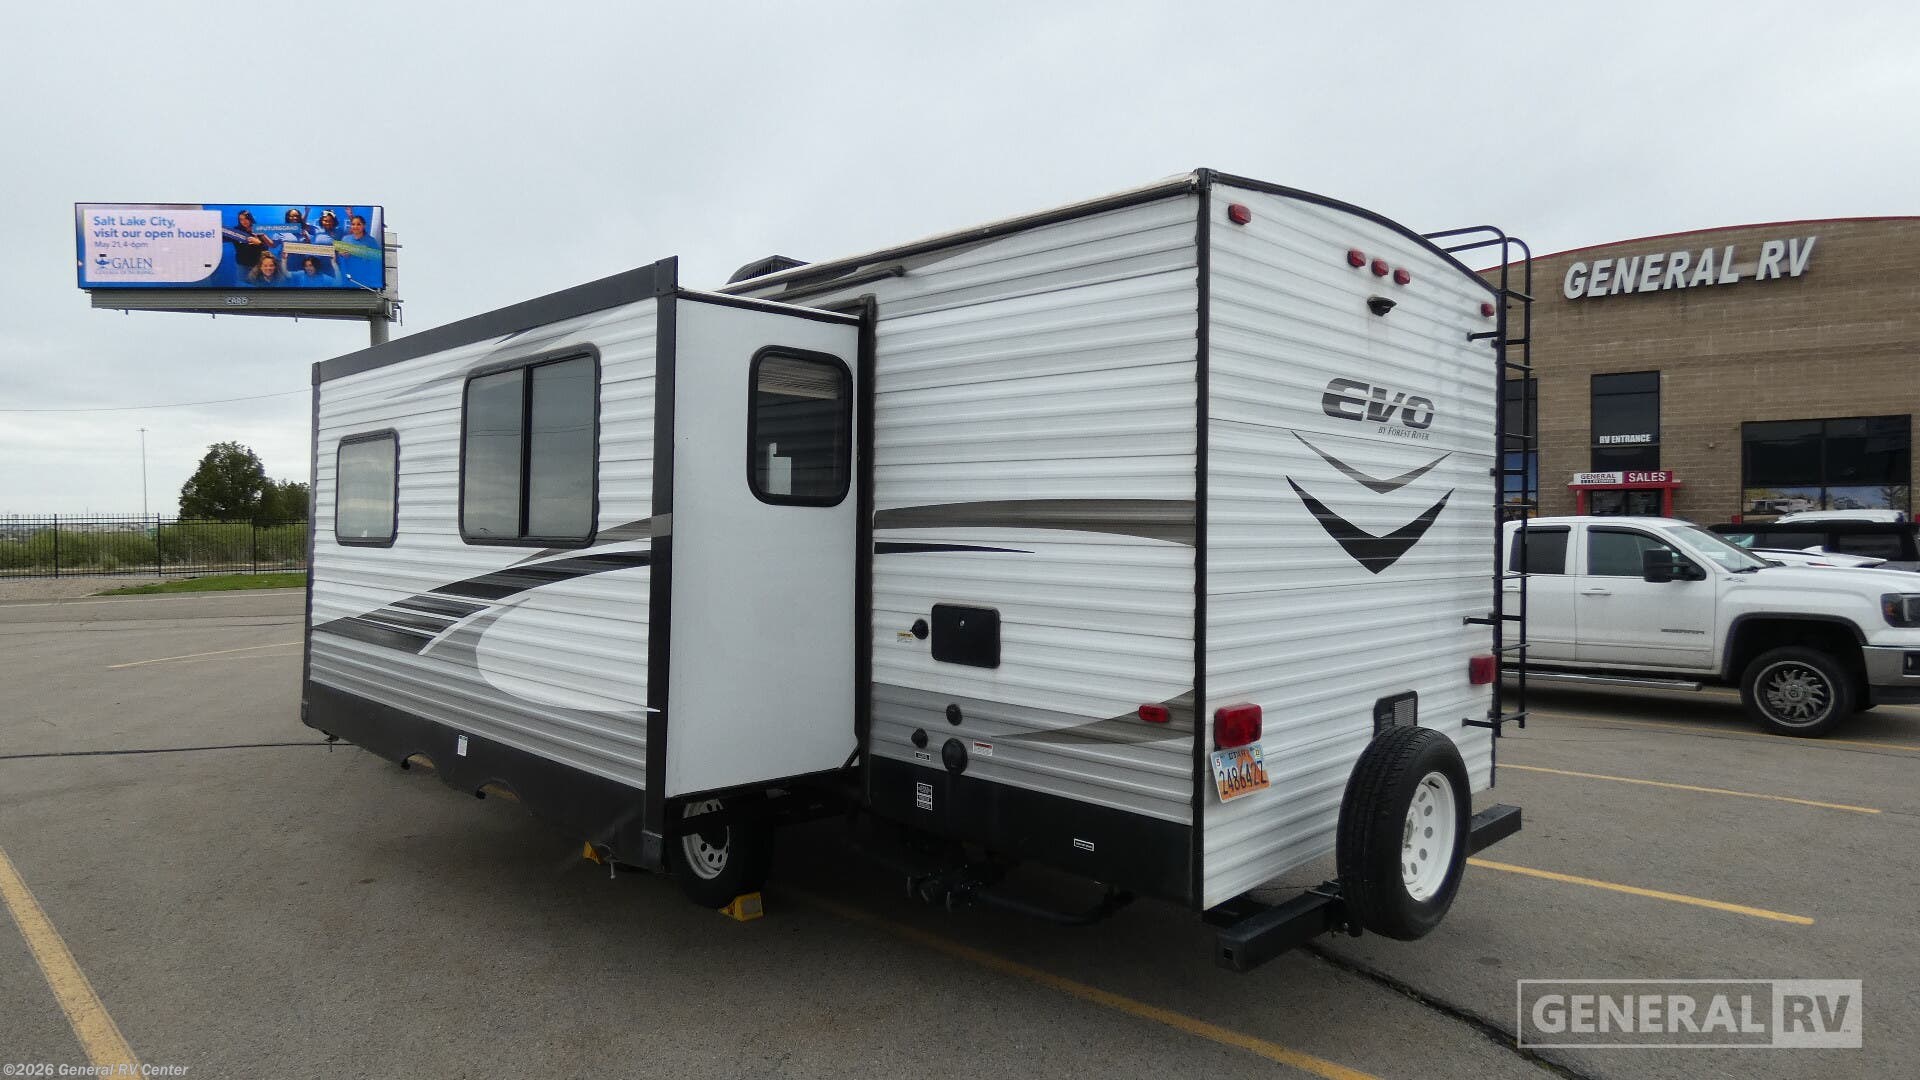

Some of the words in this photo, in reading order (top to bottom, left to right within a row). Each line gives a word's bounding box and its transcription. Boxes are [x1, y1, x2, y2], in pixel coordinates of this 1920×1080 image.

[93, 216, 116, 226] Salt
[119, 216, 146, 226] Lake
[150, 216, 175, 228] City,
[94, 228, 119, 238] visit
[122, 230, 142, 238] our
[144, 230, 174, 240] open
[177, 229, 216, 239] house!
[94, 241, 110, 249] May
[112, 258, 153, 269] GALEN
[1563, 245, 1742, 300] GENERAL
[1755, 236, 1817, 282] RV
[1321, 377, 1435, 430] EVO
[1599, 435, 1610, 444] RV
[1611, 434, 1651, 443] ENTRANCE
[1628, 471, 1667, 483] SALES
